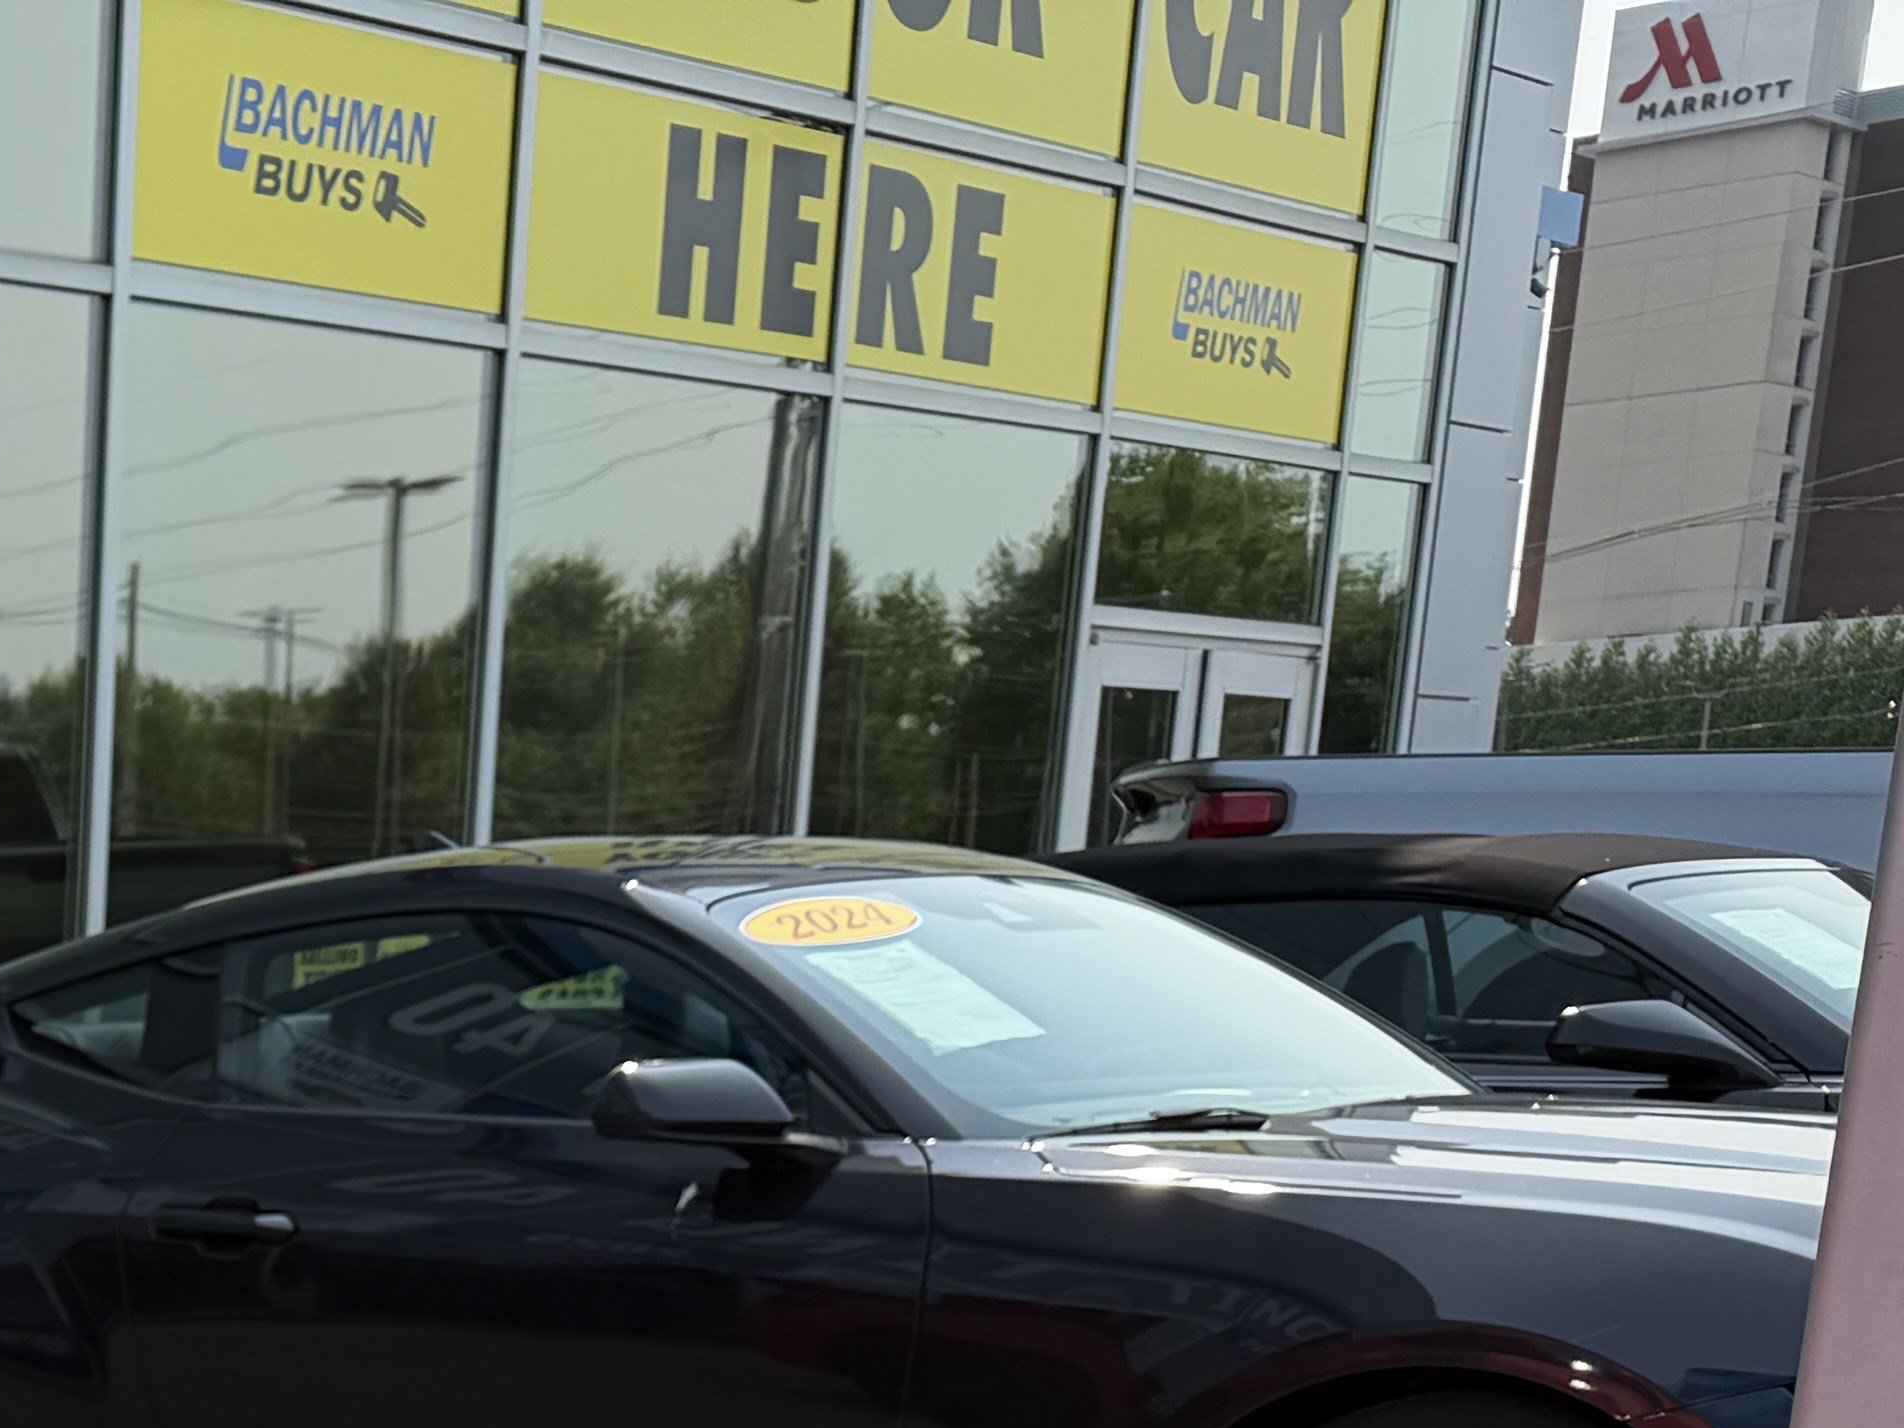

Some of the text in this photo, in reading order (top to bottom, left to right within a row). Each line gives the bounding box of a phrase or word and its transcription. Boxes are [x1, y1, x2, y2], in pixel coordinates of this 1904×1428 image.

[233, 76, 436, 168] BACHMAN
[1636, 78, 1794, 122] MARRIOTT
[254, 153, 365, 212] BUYS
[657, 122, 1006, 368] HERE
[1182, 269, 1303, 333] BACHMAN
[1190, 327, 1259, 369] BUYS
[775, 901, 893, 940] 2024
